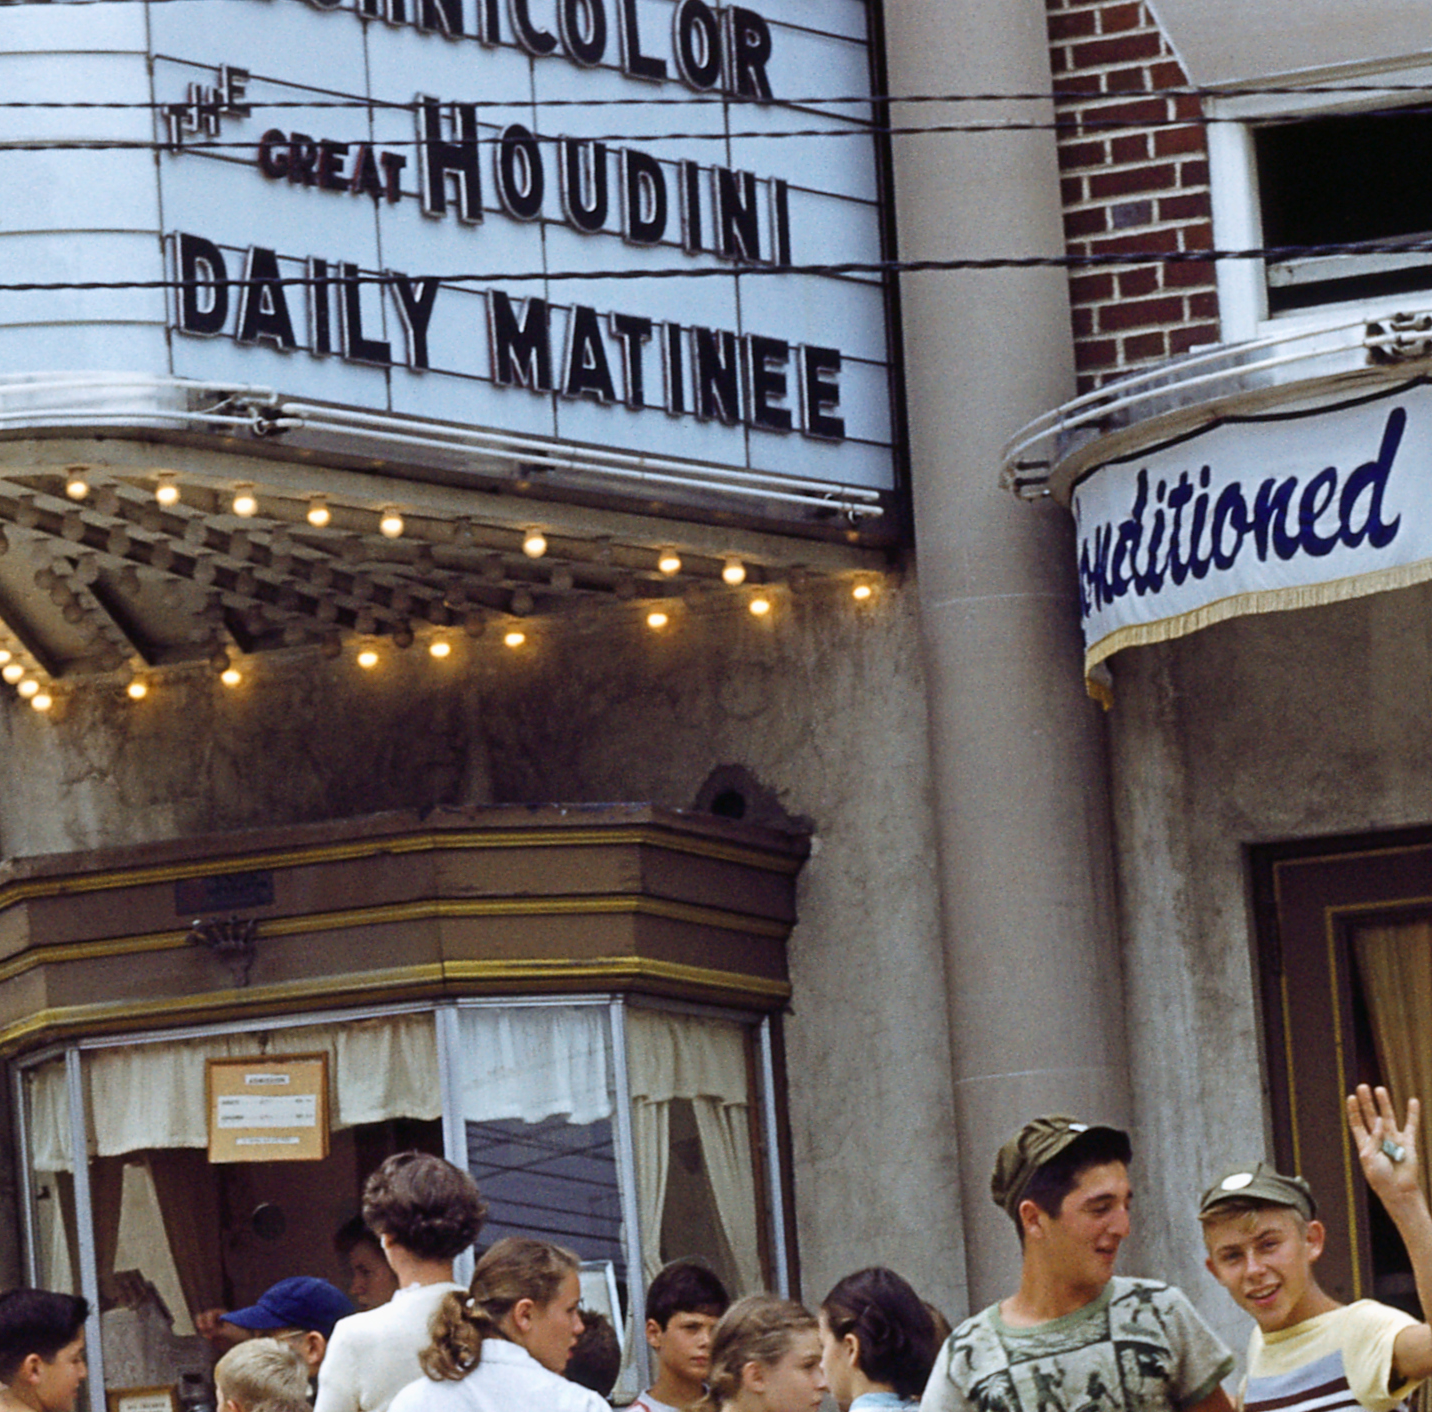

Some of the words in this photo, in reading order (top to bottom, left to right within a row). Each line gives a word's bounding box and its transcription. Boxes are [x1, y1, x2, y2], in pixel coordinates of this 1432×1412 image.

[163, 62, 252, 154] THE
[258, 128, 406, 204] GREAT
[416, 92, 791, 267] HOUDINI
[173, 230, 441, 374] DAILY
[485, 287, 847, 443] MATINEE
[1076, 406, 1407, 618] onditioned
